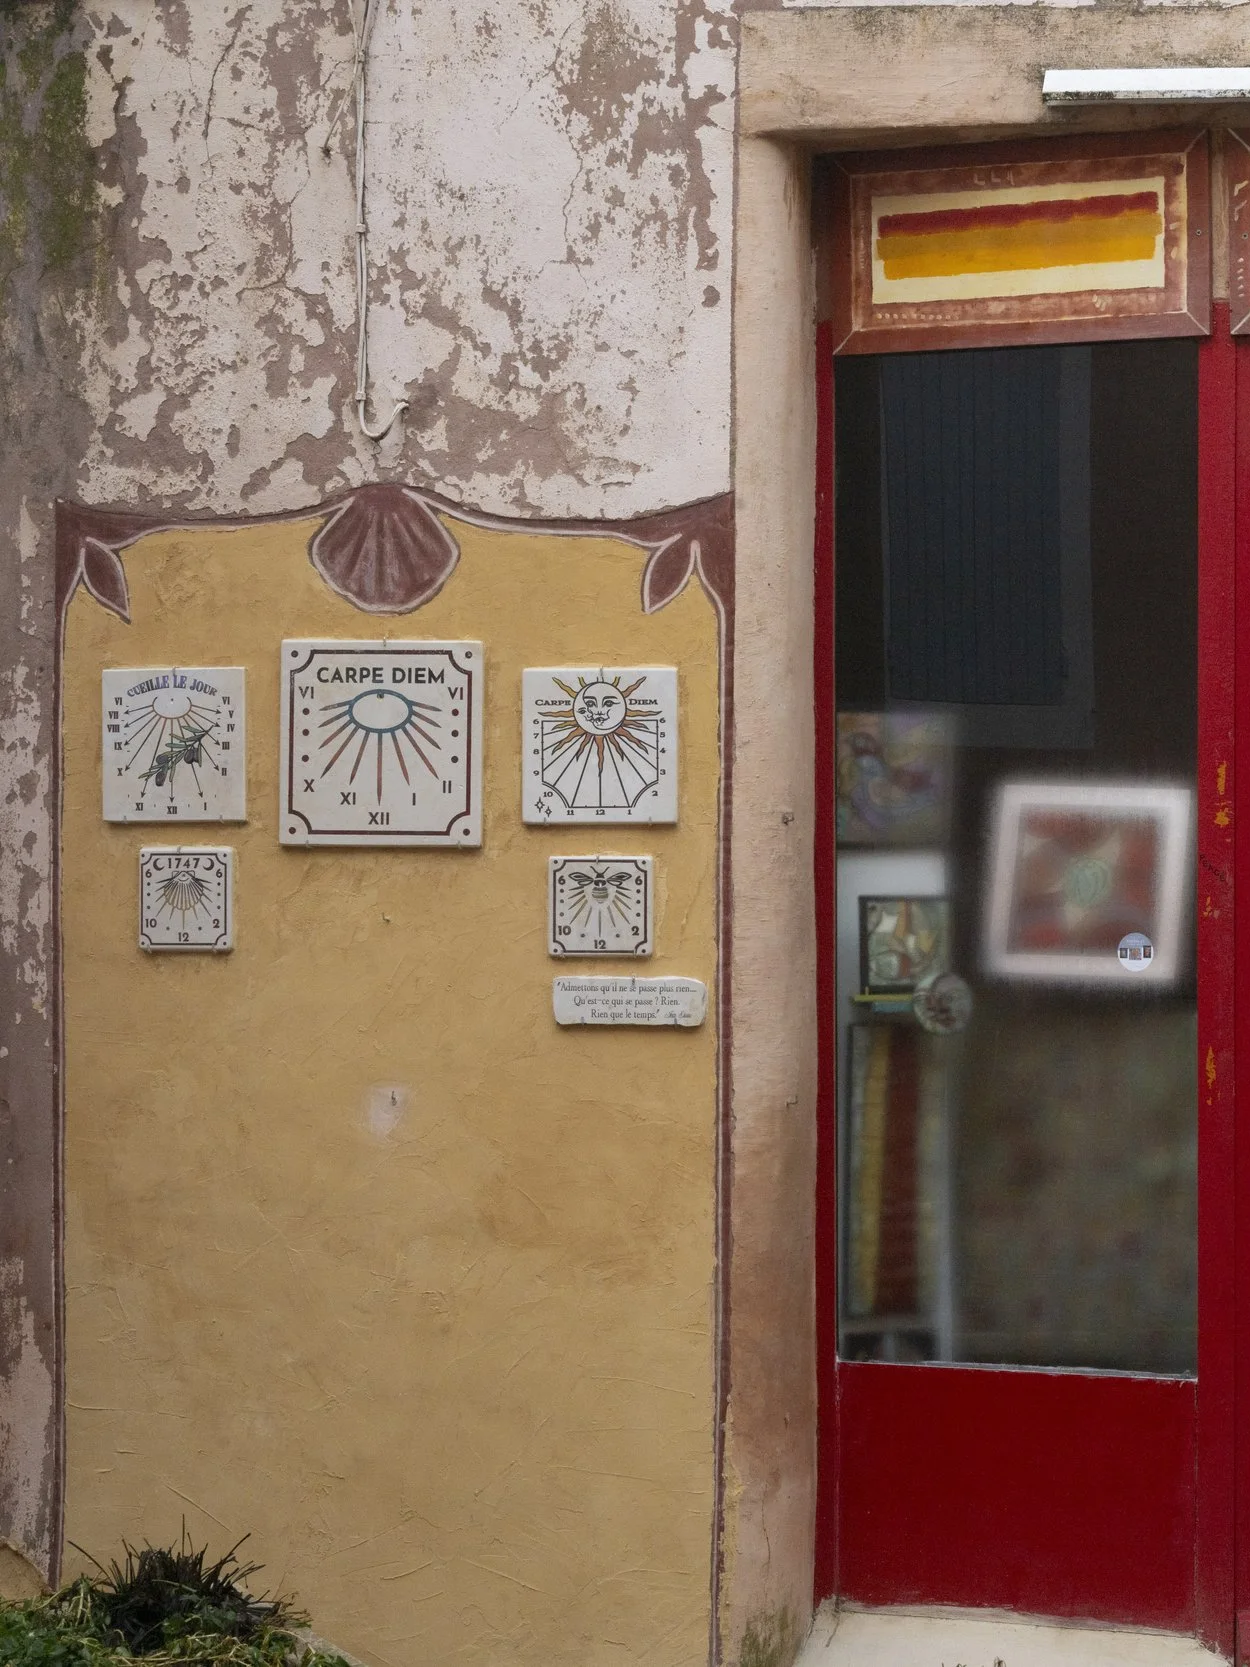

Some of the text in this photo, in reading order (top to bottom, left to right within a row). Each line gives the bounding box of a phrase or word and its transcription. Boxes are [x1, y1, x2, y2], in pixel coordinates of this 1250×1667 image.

[317, 667, 445, 684] CARPE DIEM
[127, 675, 218, 697] CUEILLE LE JOUR
[298, 686, 314, 699] VI
[448, 687, 464, 700] VI
[115, 697, 122, 706] VI
[222, 696, 230, 705] VI
[108, 711, 119, 719] VII
[229, 710, 234, 718] V
[107, 724, 120, 733] VIII
[227, 724, 235, 732] IV
[114, 742, 122, 750] IX
[222, 742, 230, 750] III
[117, 768, 123, 777] X
[222, 768, 227, 776] II
[303, 779, 315, 792] X
[442, 780, 452, 793] II
[340, 792, 356, 805] XI
[412, 793, 416, 806] I
[135, 803, 143, 811] XI
[167, 806, 177, 814] XII
[204, 802, 207, 810] I
[368, 812, 389, 825] XII
[168, 858, 200, 869] 1747
[146, 869, 152, 878] 6
[216, 869, 222, 878] 6
[558, 875, 565, 885] 6
[635, 876, 642, 885] 6
[145, 919, 157, 928] 10
[213, 919, 220, 928] 2
[558, 925, 571, 936] 10
[631, 926, 639, 936] 2
[178, 932, 189, 942] 12
[594, 940, 606, 949] 12
[639, 986, 657, 994] passe
[659, 981, 673, 994] plus
[612, 996, 623, 1007] qui
[634, 999, 653, 1007] passe
[591, 1009, 608, 1018] Rien
[610, 1013, 623, 1022] que
[625, 1009, 632, 1018] le
